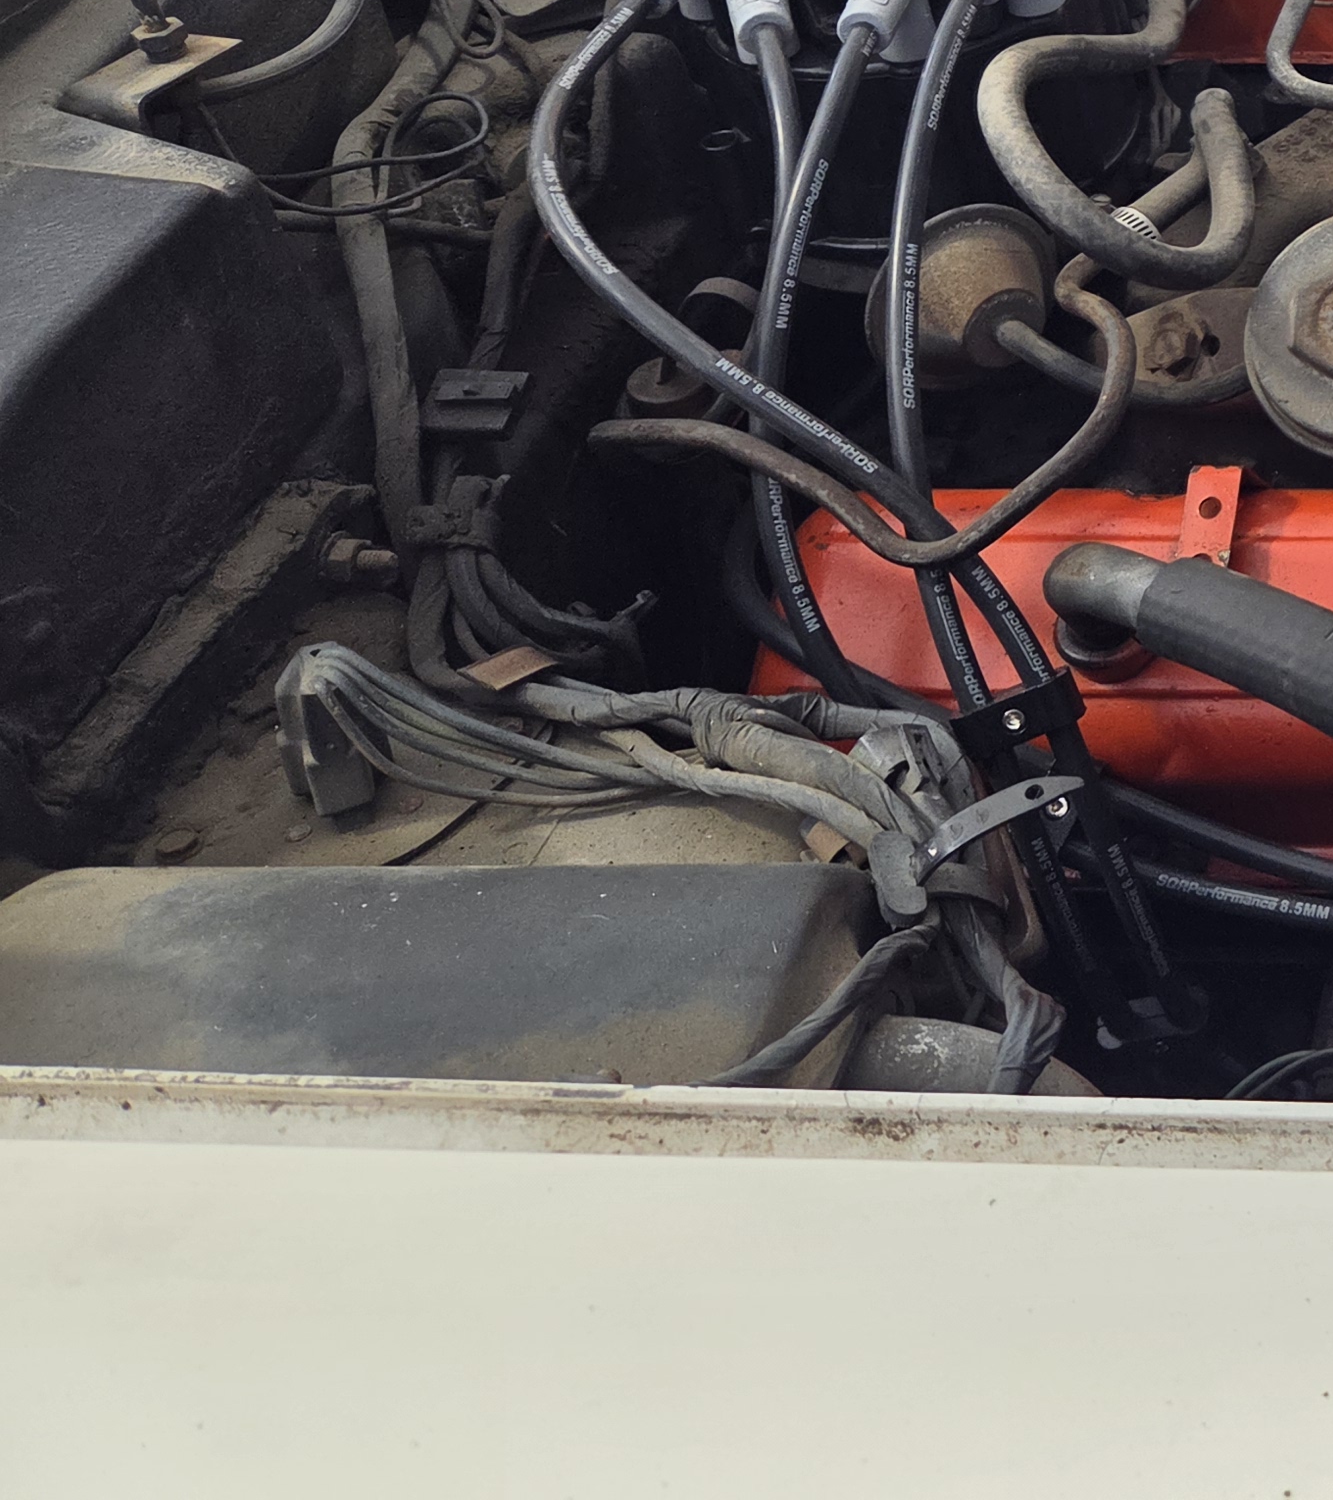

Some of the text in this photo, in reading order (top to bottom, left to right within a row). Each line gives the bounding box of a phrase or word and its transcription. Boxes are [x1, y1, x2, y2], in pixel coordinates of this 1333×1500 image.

[903, 243, 919, 290] 8.5MM
[775, 278, 796, 329] 8.5MM
[715, 357, 766, 395] 8.5MM
[792, 584, 821, 633] 8.5MM
[971, 565, 1010, 612] 8.5MM
[1107, 843, 1135, 890] 8.5MM
[1279, 899, 1331, 920] 8.5MM
